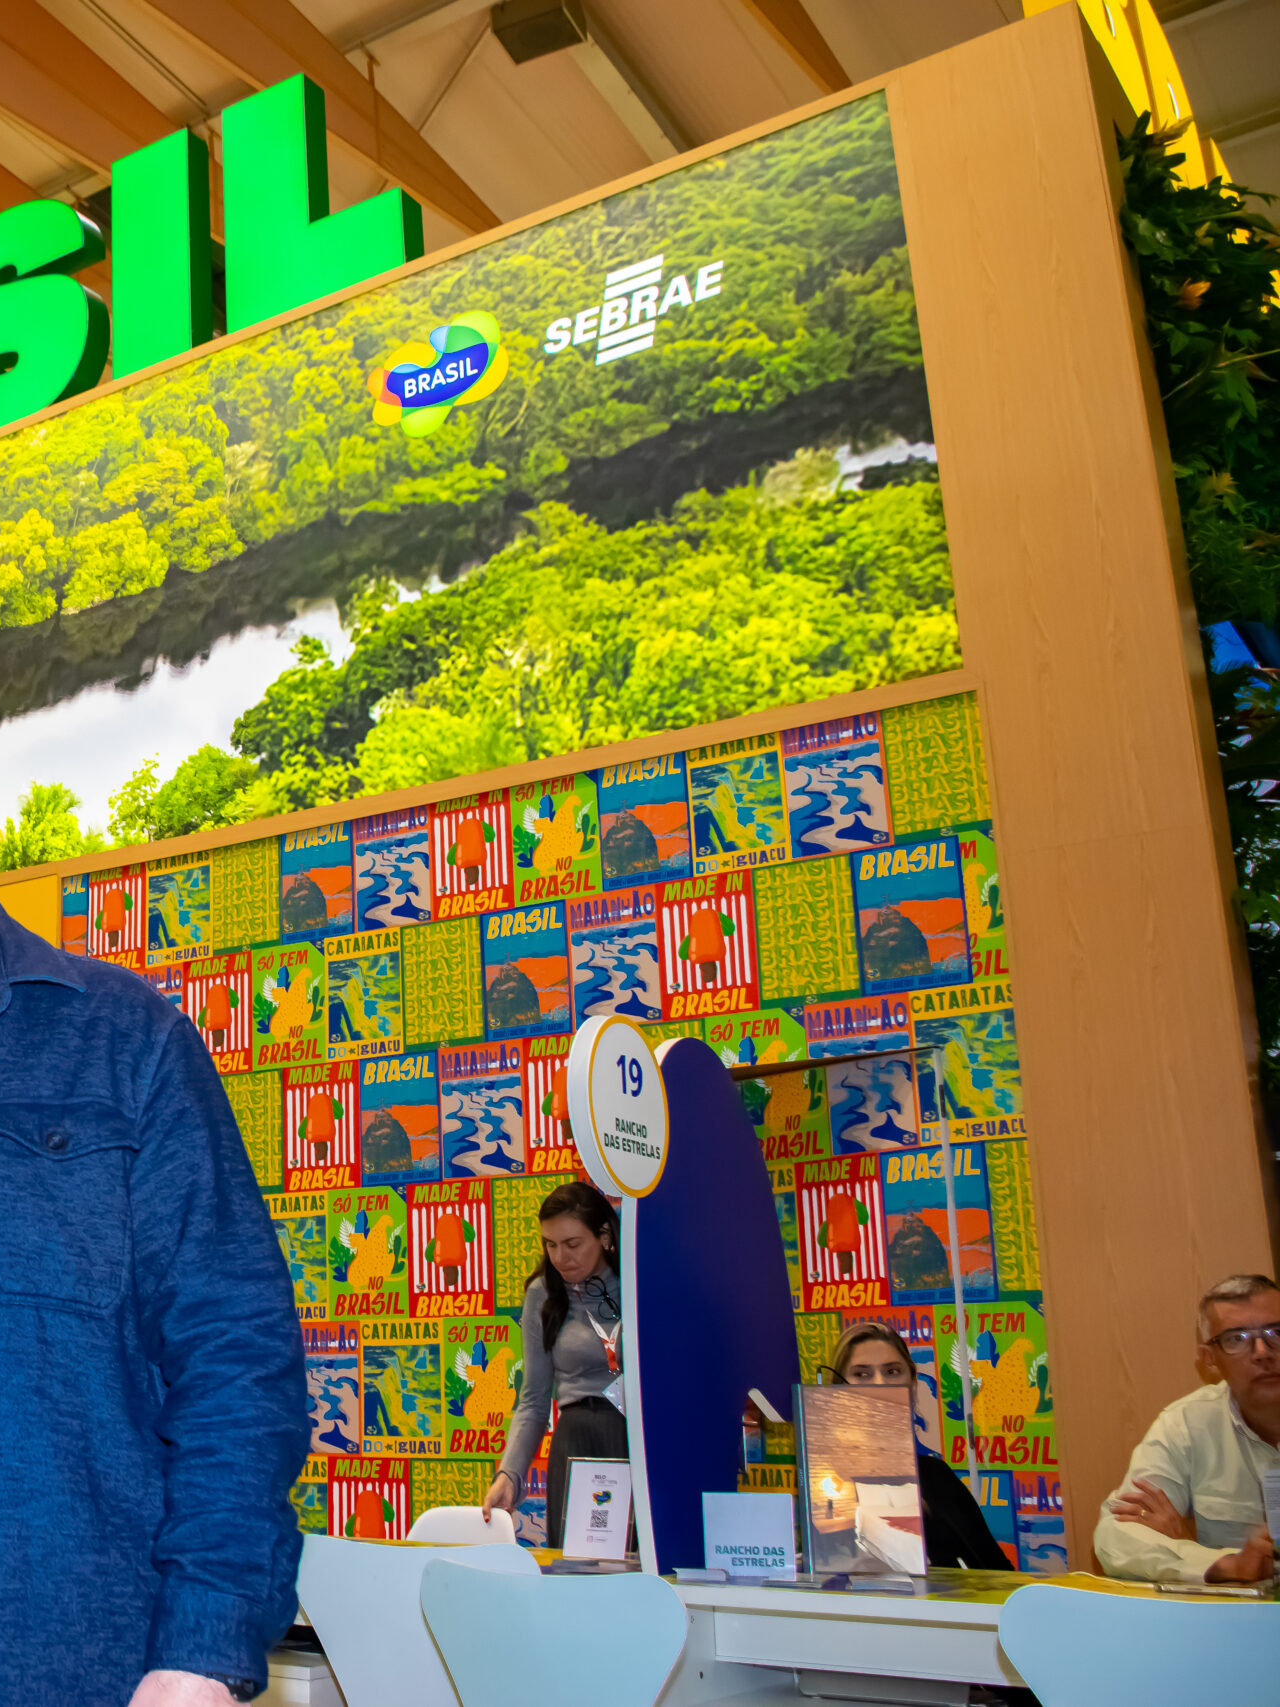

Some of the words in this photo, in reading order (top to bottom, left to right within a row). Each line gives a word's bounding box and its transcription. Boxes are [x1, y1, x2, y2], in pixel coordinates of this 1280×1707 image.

[544, 260, 724, 355] SEBRAE
[404, 357, 478, 399] BRASIL
[602, 752, 681, 789] BRASIL
[542, 774, 575, 797] TEM
[436, 793, 479, 814] MADE
[488, 788, 503, 803] IN
[285, 821, 349, 853] BRASIL
[556, 856, 572, 873] NO
[696, 859, 719, 875] DO
[859, 843, 955, 880] BRASIL
[520, 869, 597, 903] BRASIL
[663, 876, 718, 903] MADE
[726, 872, 744, 892] IN
[438, 888, 509, 919] BRASIL
[487, 906, 562, 940] BRASIL
[189, 959, 228, 978] MADE
[234, 954, 248, 971] IN
[257, 952, 273, 972] SÓ
[279, 949, 308, 967] TEM
[670, 987, 753, 1019] BRASIL
[289, 1024, 304, 1040] NO
[710, 1019, 733, 1043] SÓ
[741, 1017, 780, 1039] TEM
[257, 1038, 322, 1066] BRASIL
[328, 1047, 347, 1060] DO
[529, 1036, 573, 1058] MAD
[288, 1063, 332, 1085] MADE
[338, 1062, 353, 1079] IN
[363, 1056, 434, 1086] BRASIL
[617, 1054, 643, 1098] 19
[615, 1117, 648, 1139] RANCHO
[785, 1114, 801, 1132] NO
[604, 1132, 621, 1150] DAS
[622, 1135, 661, 1160] ESTRELAS
[803, 1158, 852, 1184] MADE
[859, 1156, 876, 1177] IN
[887, 1148, 980, 1184] BRASIL
[289, 1167, 355, 1191] BRASIL
[333, 1193, 351, 1214] SÓ
[357, 1194, 389, 1211] TEM
[414, 1183, 462, 1204] MADE
[468, 1181, 485, 1199] IN
[368, 1276, 384, 1290] NO
[334, 1292, 405, 1316] BRASIL
[416, 1294, 489, 1317] BRASIL
[811, 1282, 887, 1309] BRASIL
[448, 1322, 468, 1343] SÓ
[474, 1325, 509, 1342] TEM
[977, 1312, 1026, 1333] TEM
[486, 1411, 504, 1427] NO
[1002, 1415, 1025, 1433] NO
[363, 1440, 383, 1453] DO
[450, 1429, 506, 1454] BRAS
[951, 1435, 1058, 1465] BRASIL
[334, 1459, 381, 1478] MADE
[388, 1460, 404, 1479] IN
[715, 1545, 760, 1556] RANCHO
[763, 1546, 785, 1557] DAS
[731, 1557, 785, 1568] ESTRELAS
